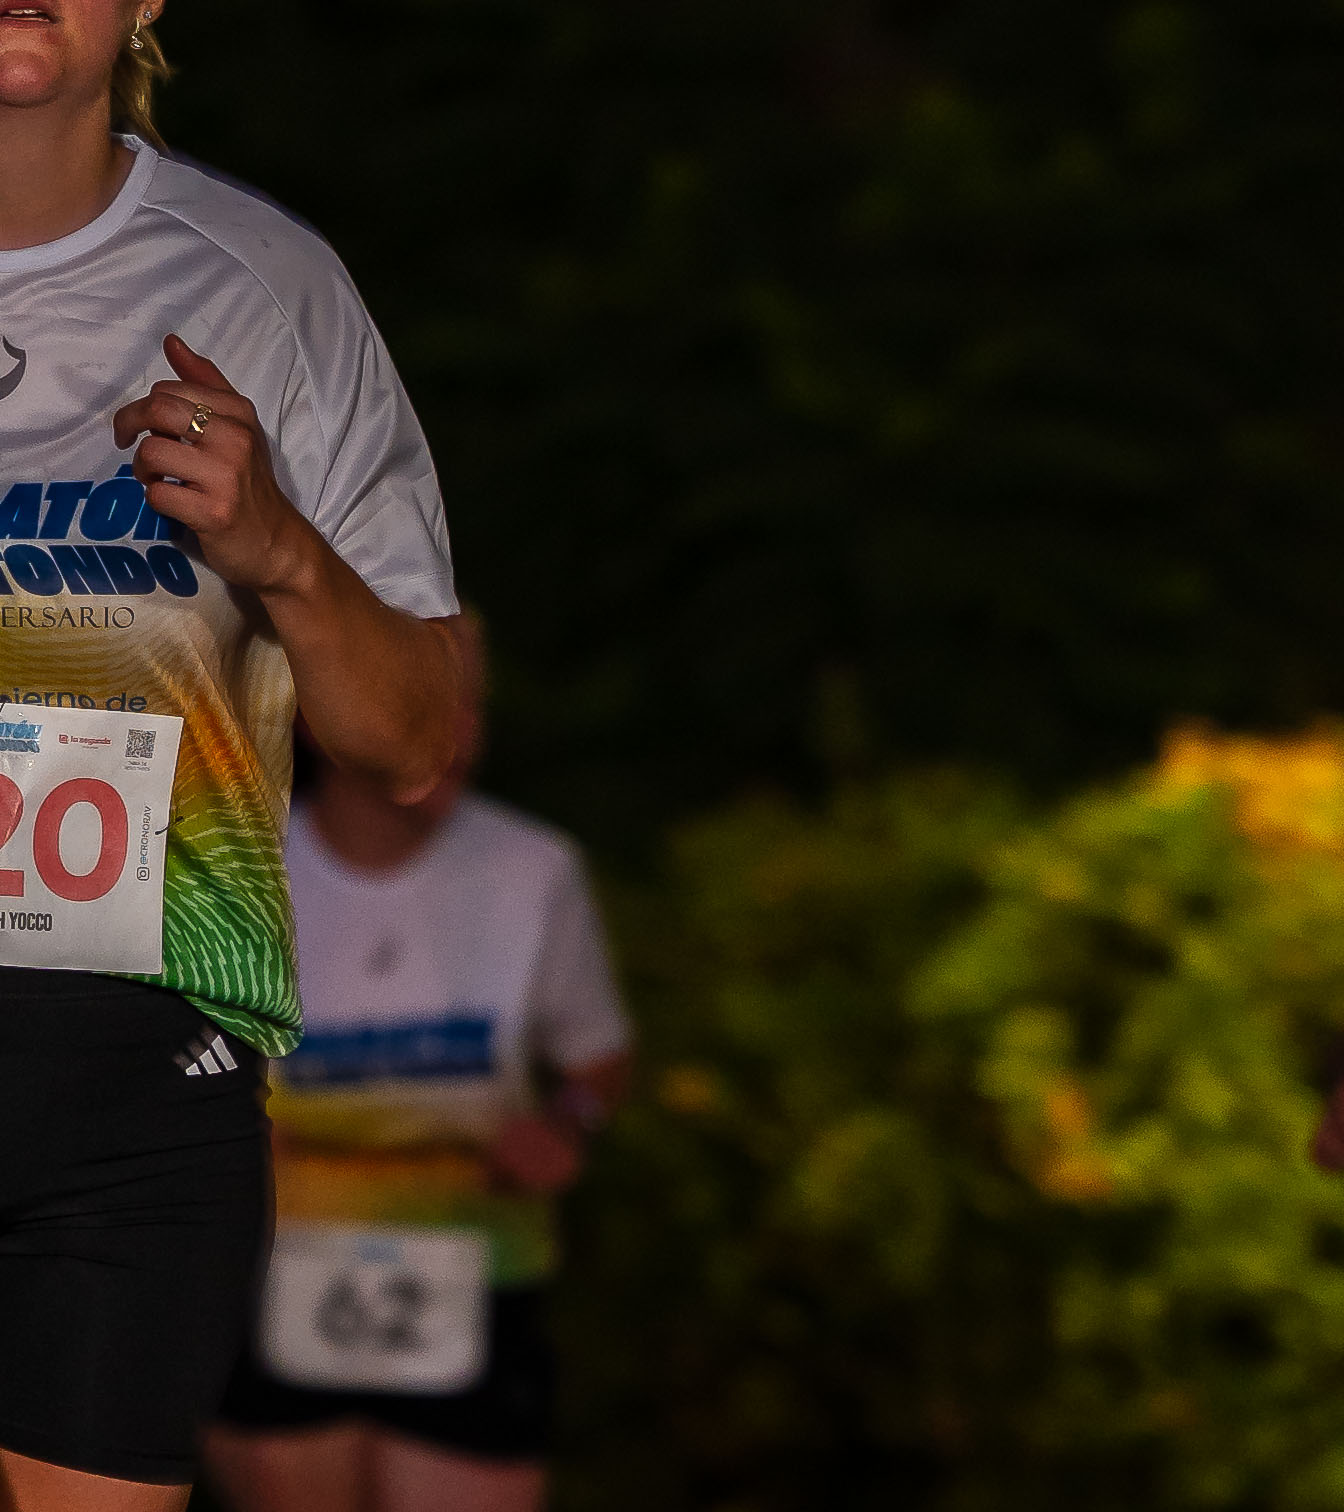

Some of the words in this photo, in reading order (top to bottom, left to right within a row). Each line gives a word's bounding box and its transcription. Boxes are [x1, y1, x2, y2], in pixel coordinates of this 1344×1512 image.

[106, 692, 148, 713] de
[139, 805, 152, 865] @CRONORAV
[8, 911, 53, 932] YOCCO
